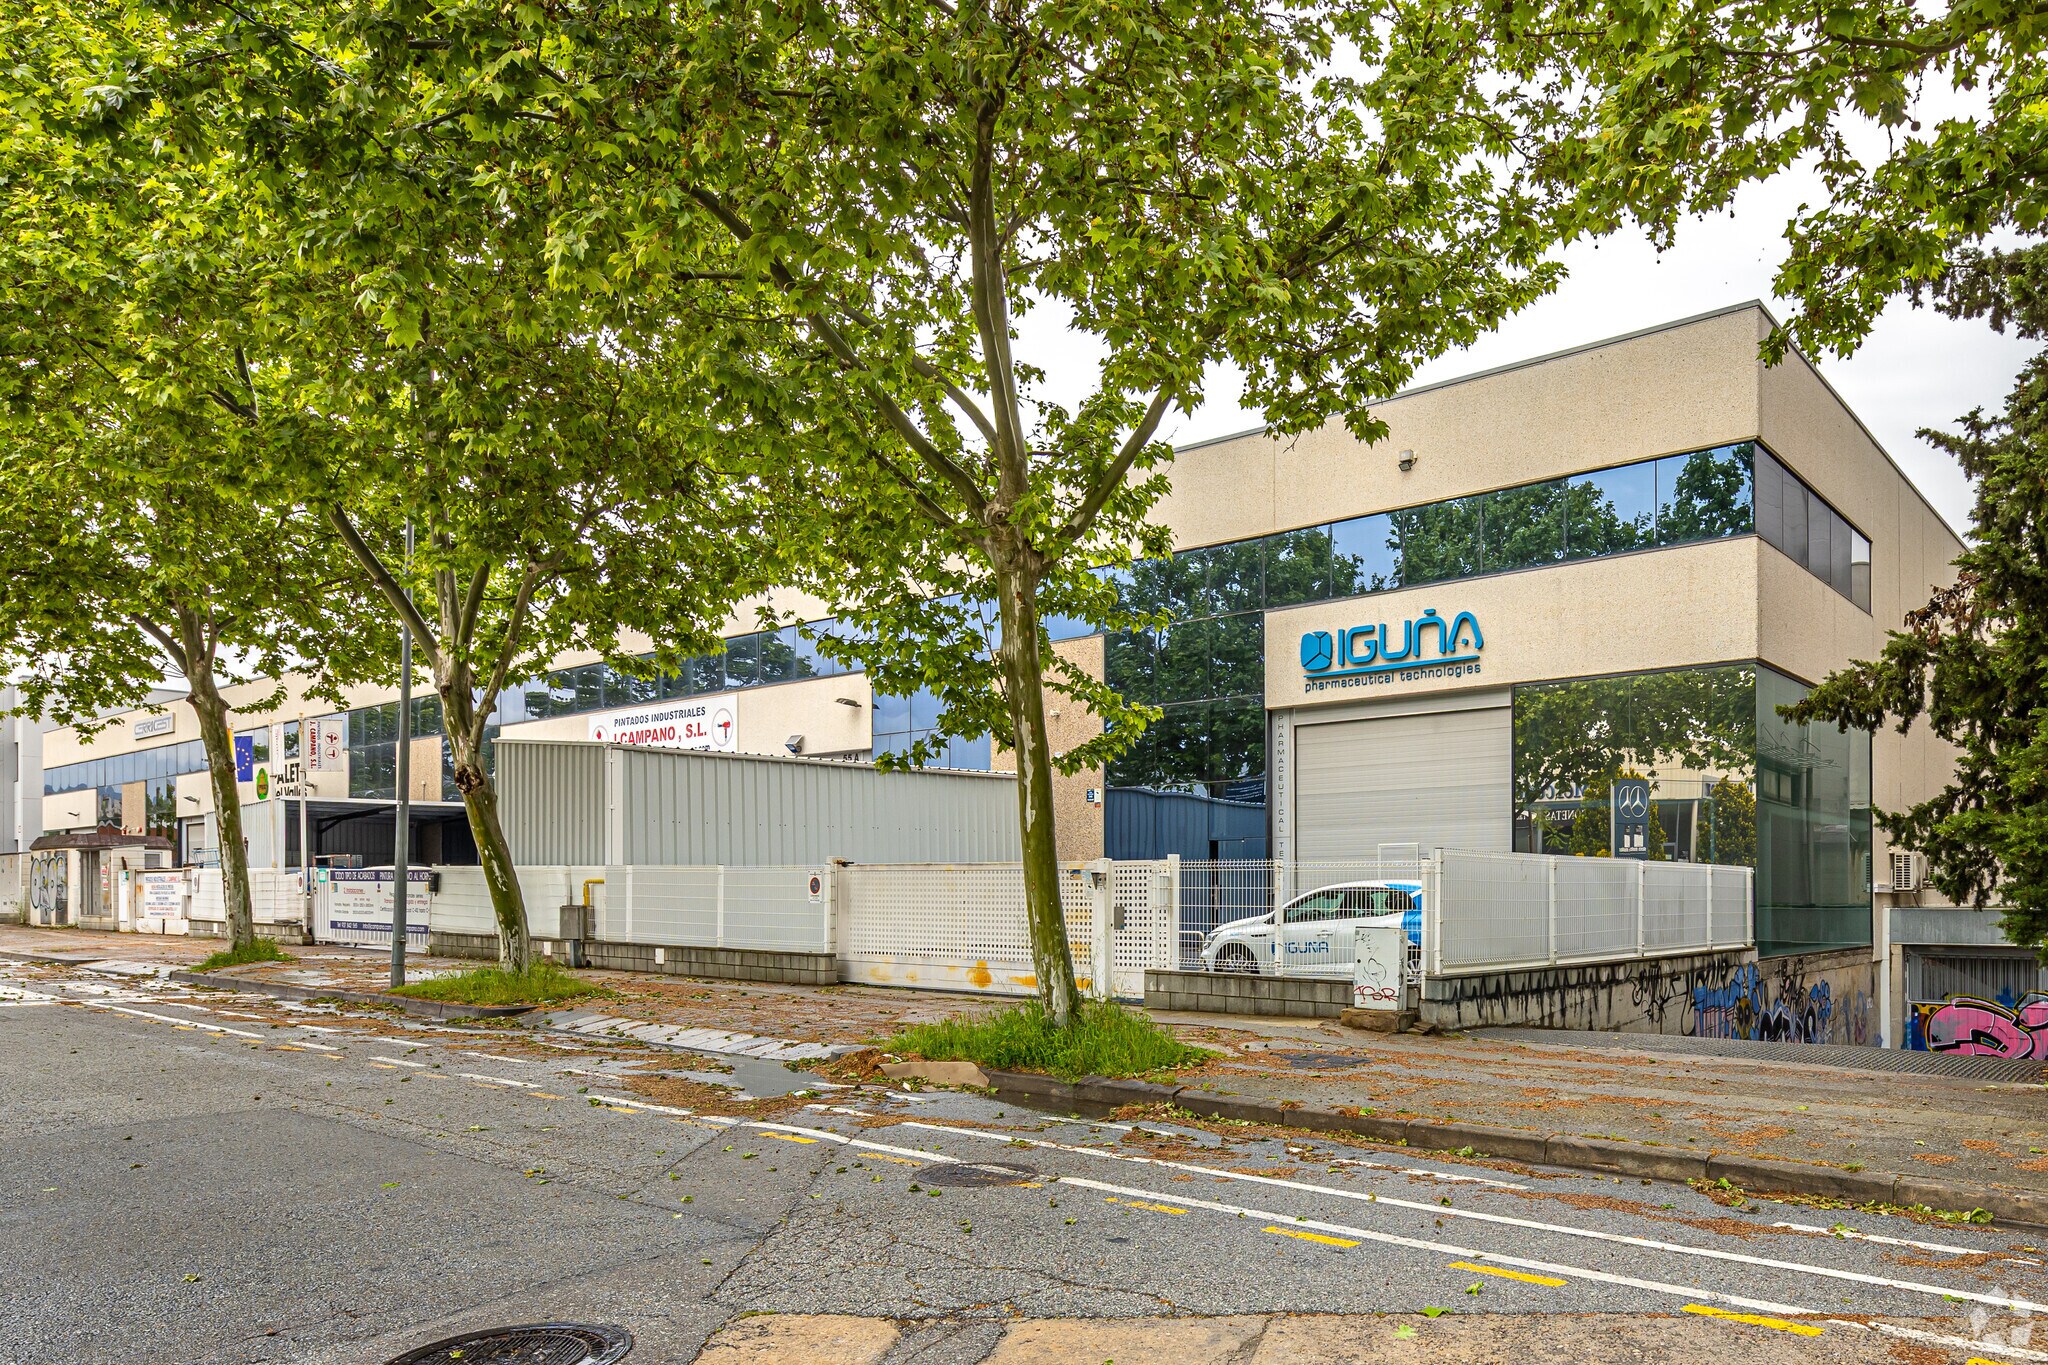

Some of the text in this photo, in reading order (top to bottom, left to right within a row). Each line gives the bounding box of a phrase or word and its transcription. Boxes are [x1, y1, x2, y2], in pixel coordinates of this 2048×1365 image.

[1338, 608, 1484, 667] IGUÑA
[1305, 663, 1481, 694] pharmaceutical technologies
[614, 706, 706, 728] PINTADOS INDUSTRIALES
[685, 722, 707, 739] S.L.
